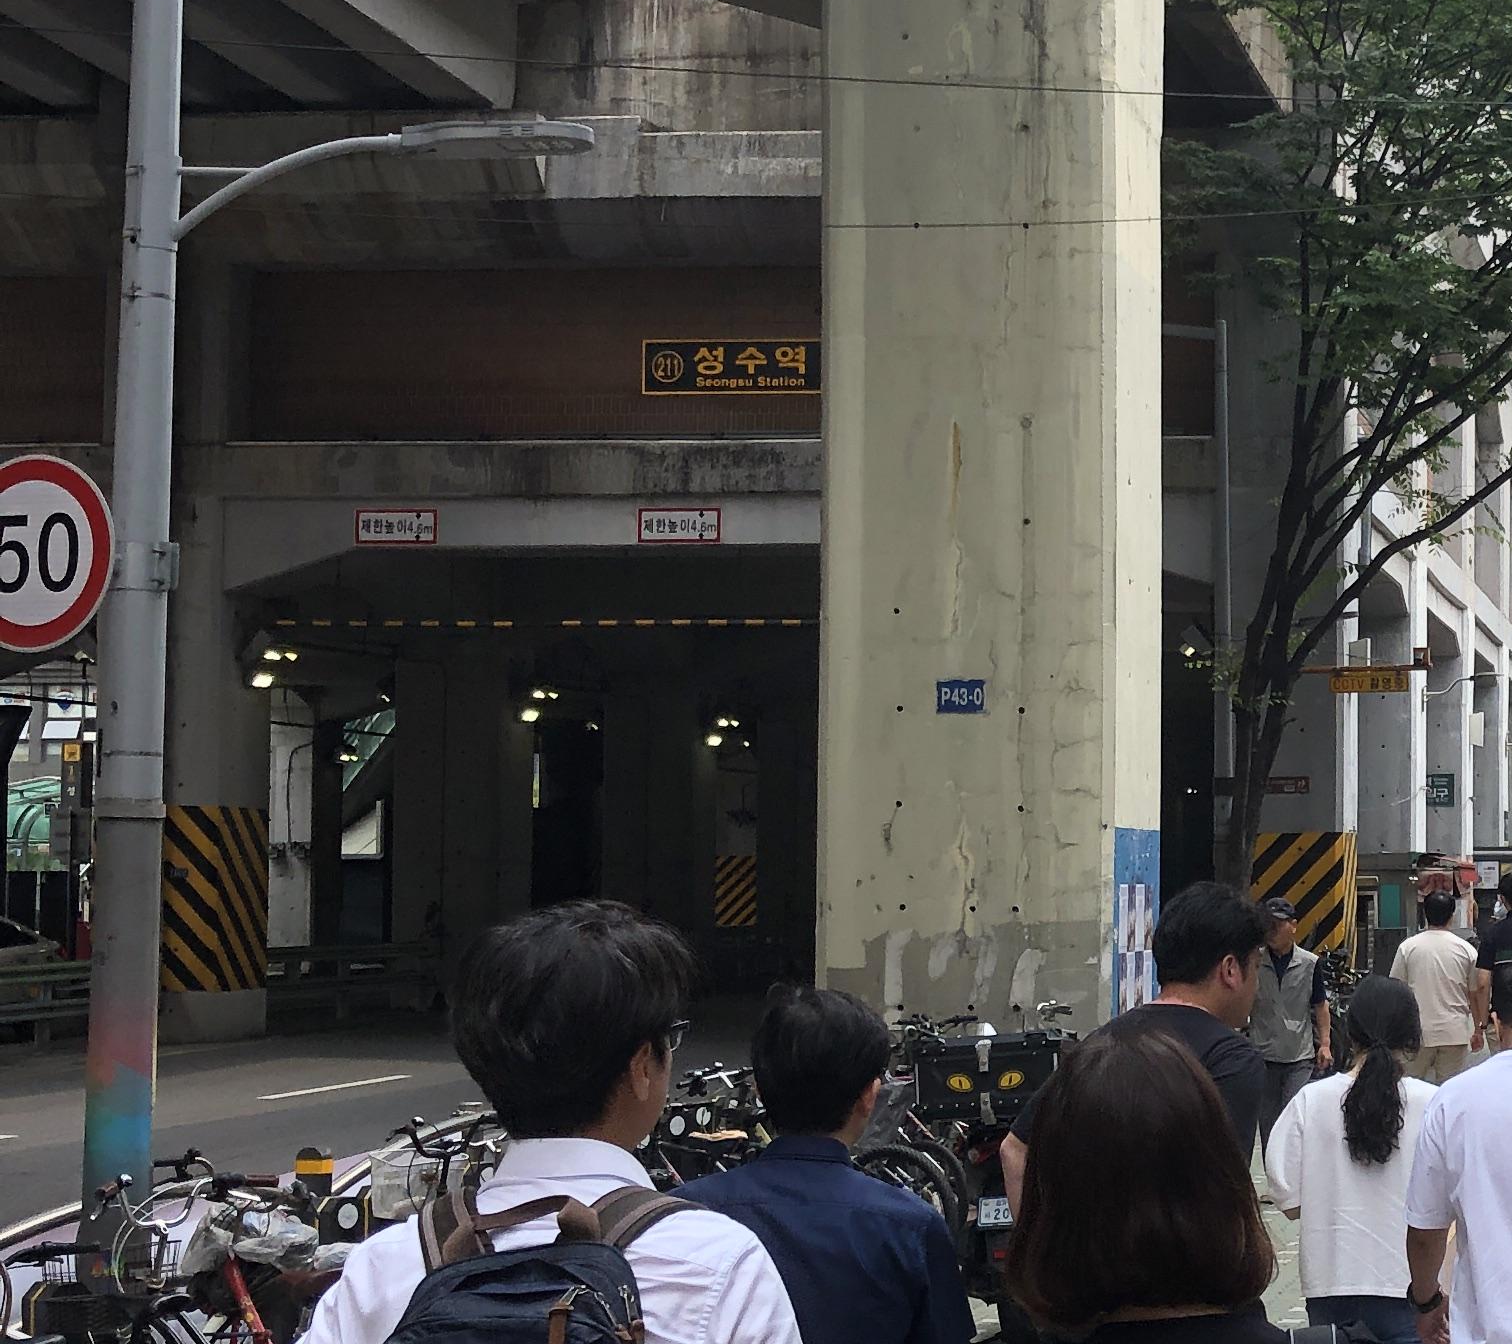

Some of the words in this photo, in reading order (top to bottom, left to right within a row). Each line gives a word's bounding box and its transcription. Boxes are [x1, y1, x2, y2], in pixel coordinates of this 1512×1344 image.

[657, 357, 681, 377] 211
[693, 345, 806, 375] 성수역
[696, 377, 753, 388] Seongsu
[757, 376, 806, 387] Station
[0, 513, 79, 593] 50
[1332, 677, 1365, 690] CCTV
[941, 687, 982, 706] P43-0
